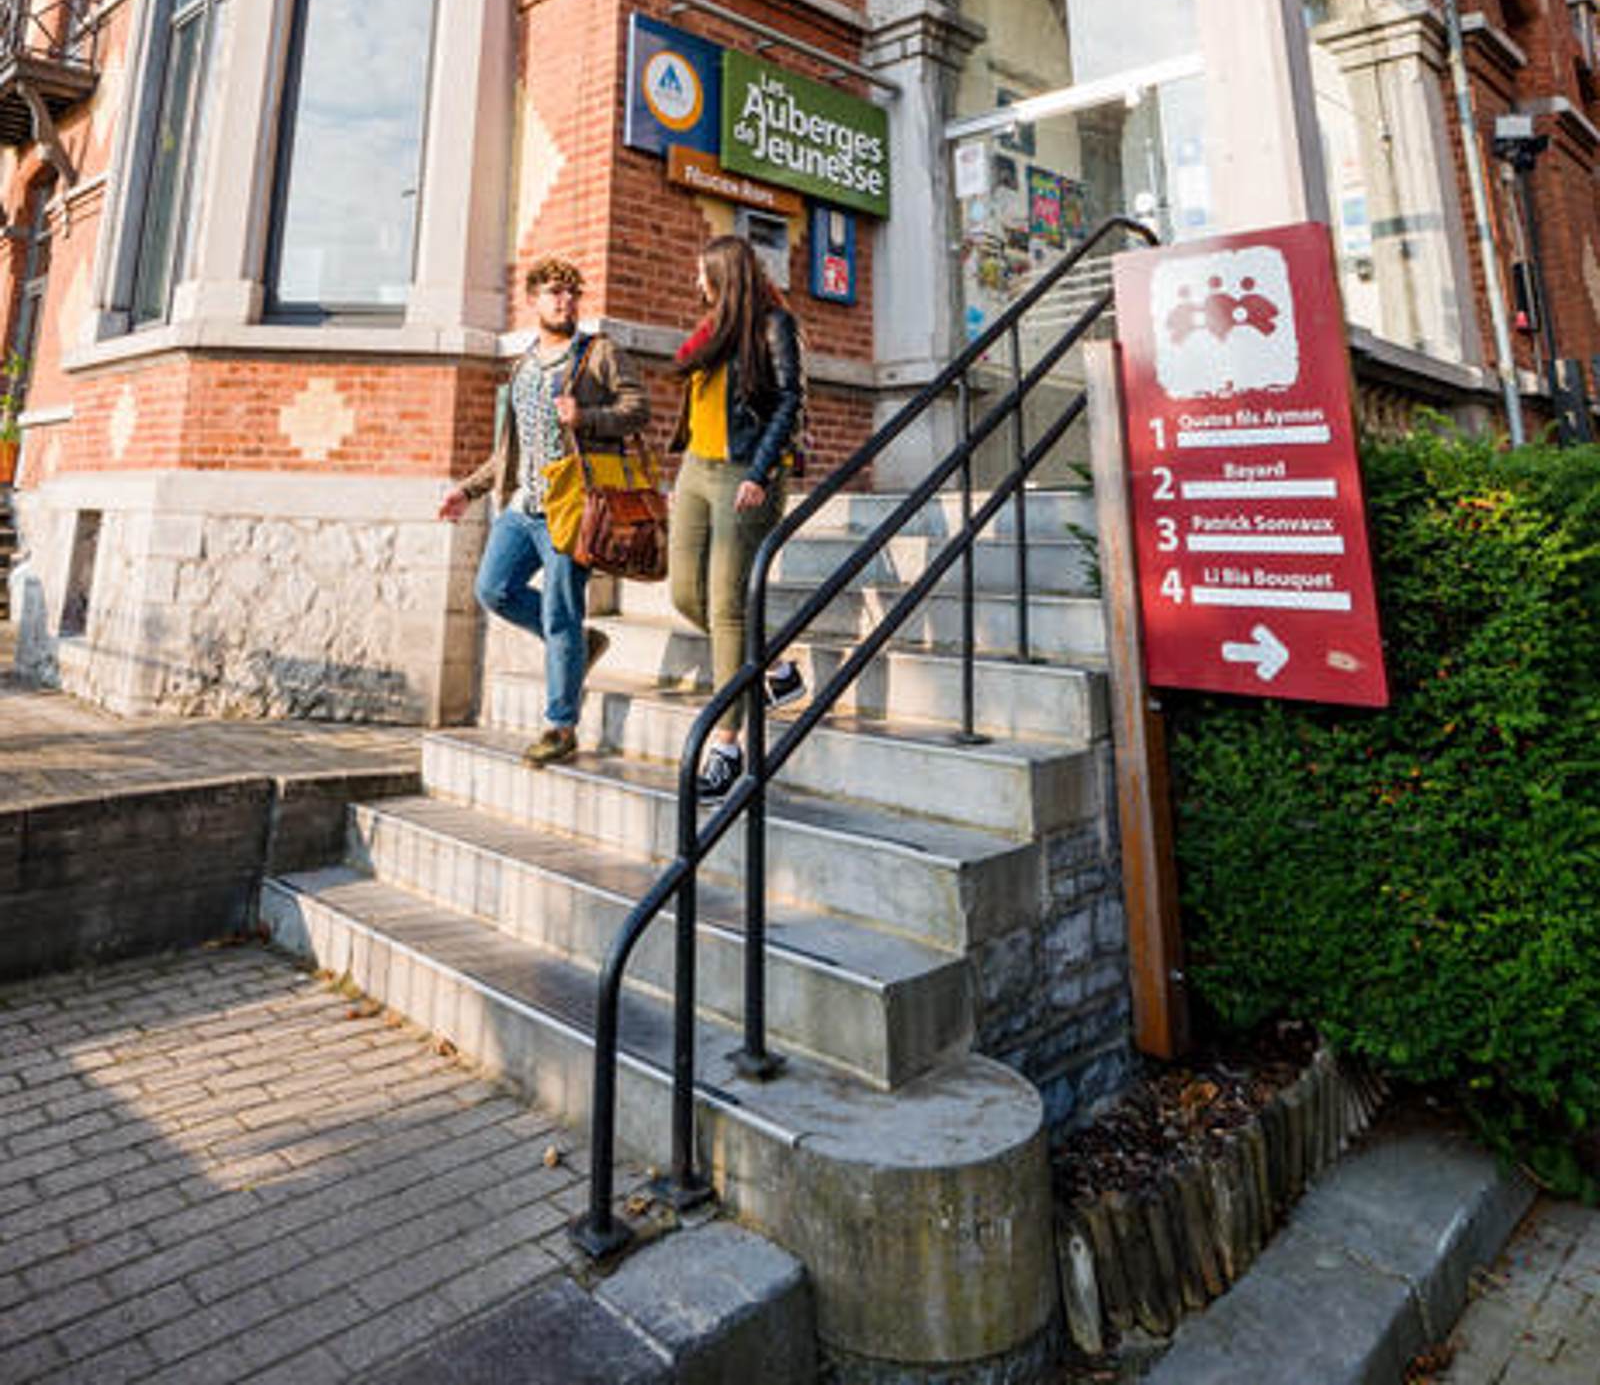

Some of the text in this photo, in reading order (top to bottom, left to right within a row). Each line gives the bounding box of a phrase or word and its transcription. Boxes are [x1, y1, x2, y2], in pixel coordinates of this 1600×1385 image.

[743, 82, 883, 167] Auberges
[752, 112, 883, 195] Jeunesse
[1149, 418, 1165, 450] 1
[1263, 408, 1324, 427] Aymon
[1152, 462, 1286, 500] 2 Bayard
[1156, 517, 1178, 551] 3
[1192, 515, 1250, 531] Patrick
[1160, 568, 1184, 604] 4
[1204, 568, 1219, 583] Li
[1253, 569, 1334, 591] Bouquet
